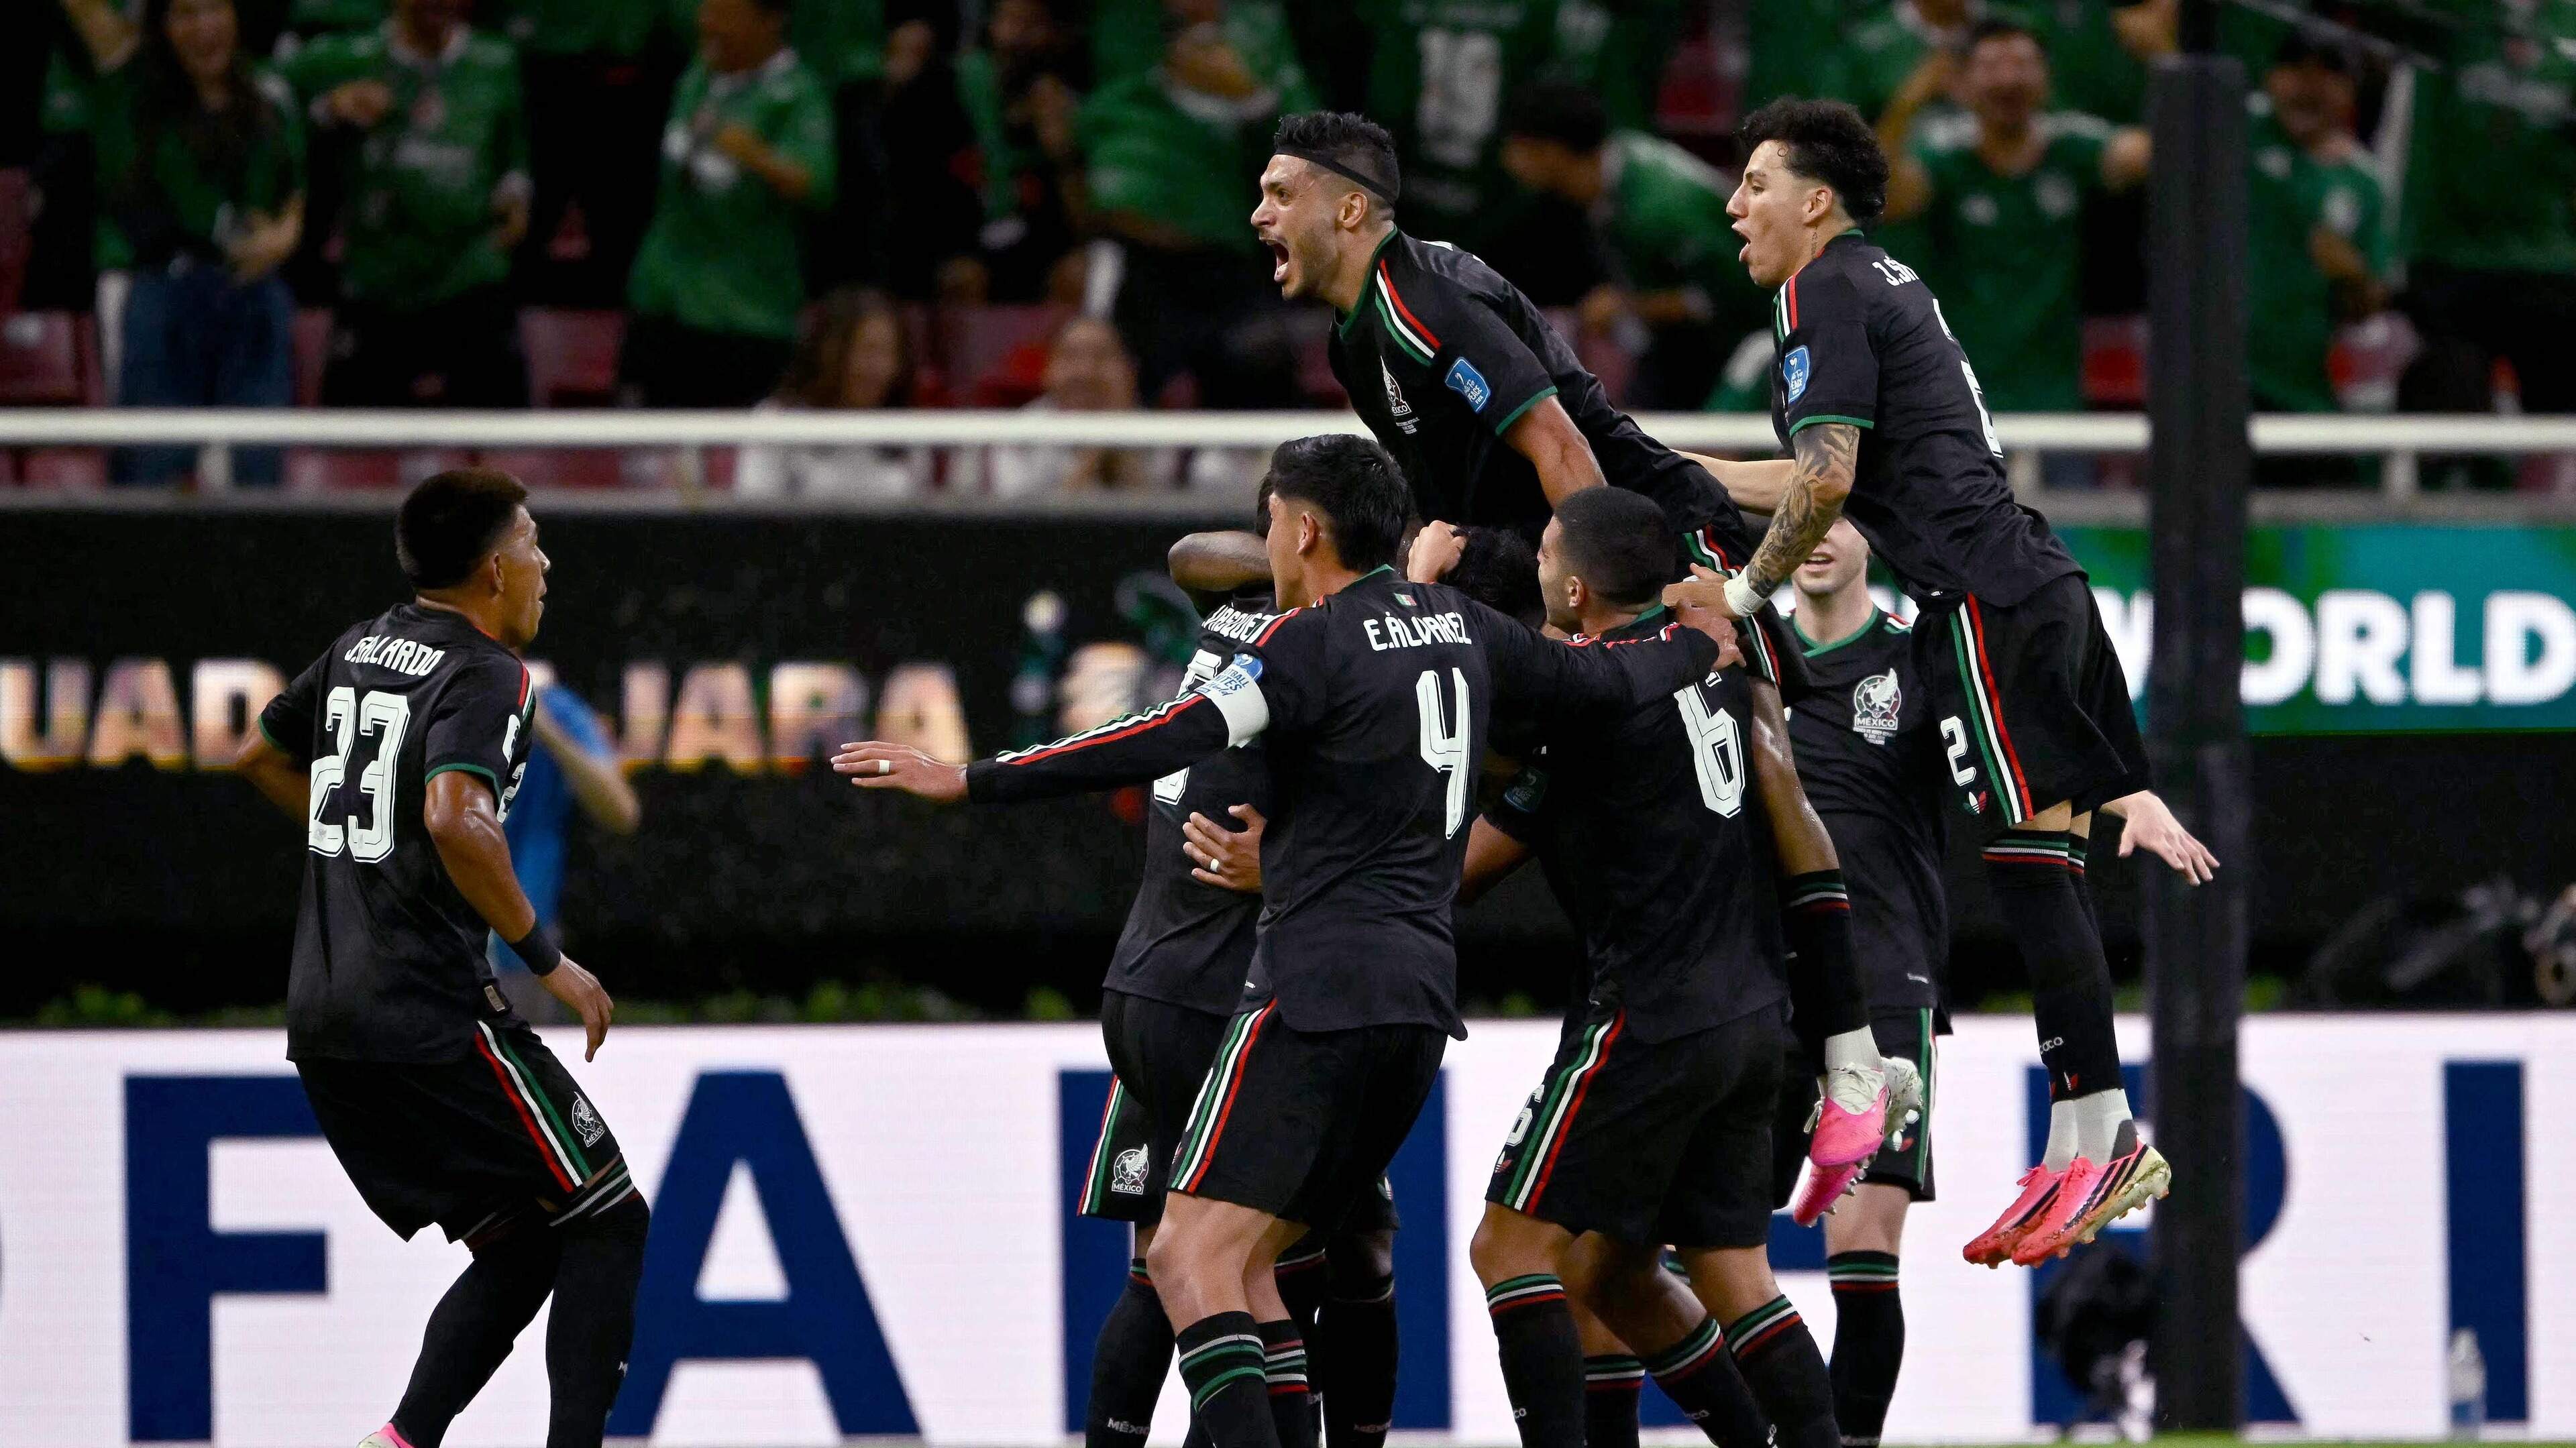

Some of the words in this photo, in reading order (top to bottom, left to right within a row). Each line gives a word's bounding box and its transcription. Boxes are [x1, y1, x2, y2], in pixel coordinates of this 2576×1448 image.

[1363, 611, 1472, 652] E.ÁLVAREZ
[309, 686, 411, 864] 23
[1415, 667, 1470, 840] 4
[1674, 671, 1746, 819] 6
[1940, 715, 1977, 787] 2
[1114, 1182, 1142, 1192] MÉXICO
